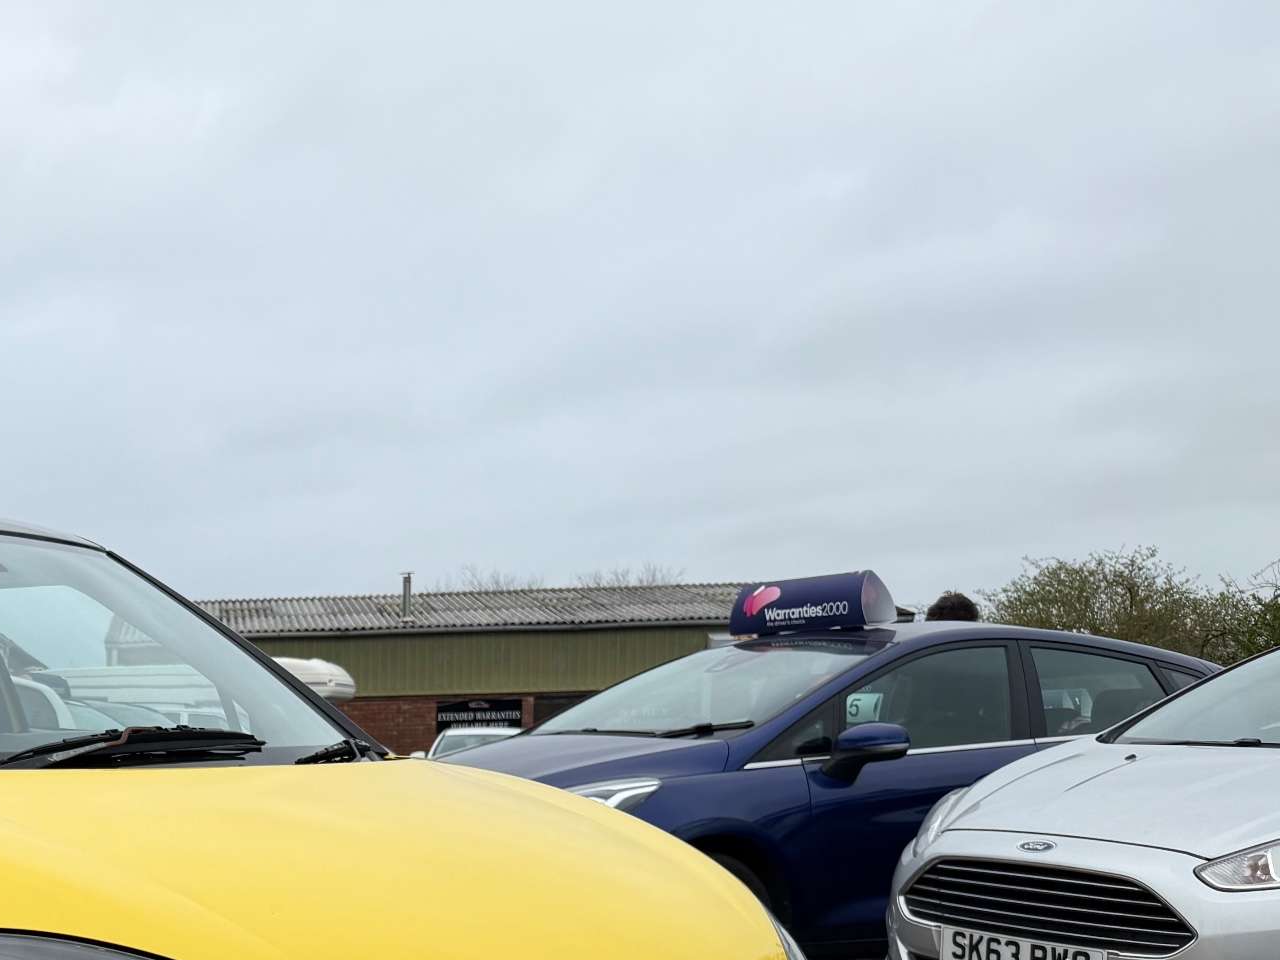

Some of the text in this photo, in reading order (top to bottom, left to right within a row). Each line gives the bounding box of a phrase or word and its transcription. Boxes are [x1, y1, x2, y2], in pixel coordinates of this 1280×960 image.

[765, 601, 848, 620] Warranties2000
[438, 711, 520, 721] EXTENDED WARRANTIES
